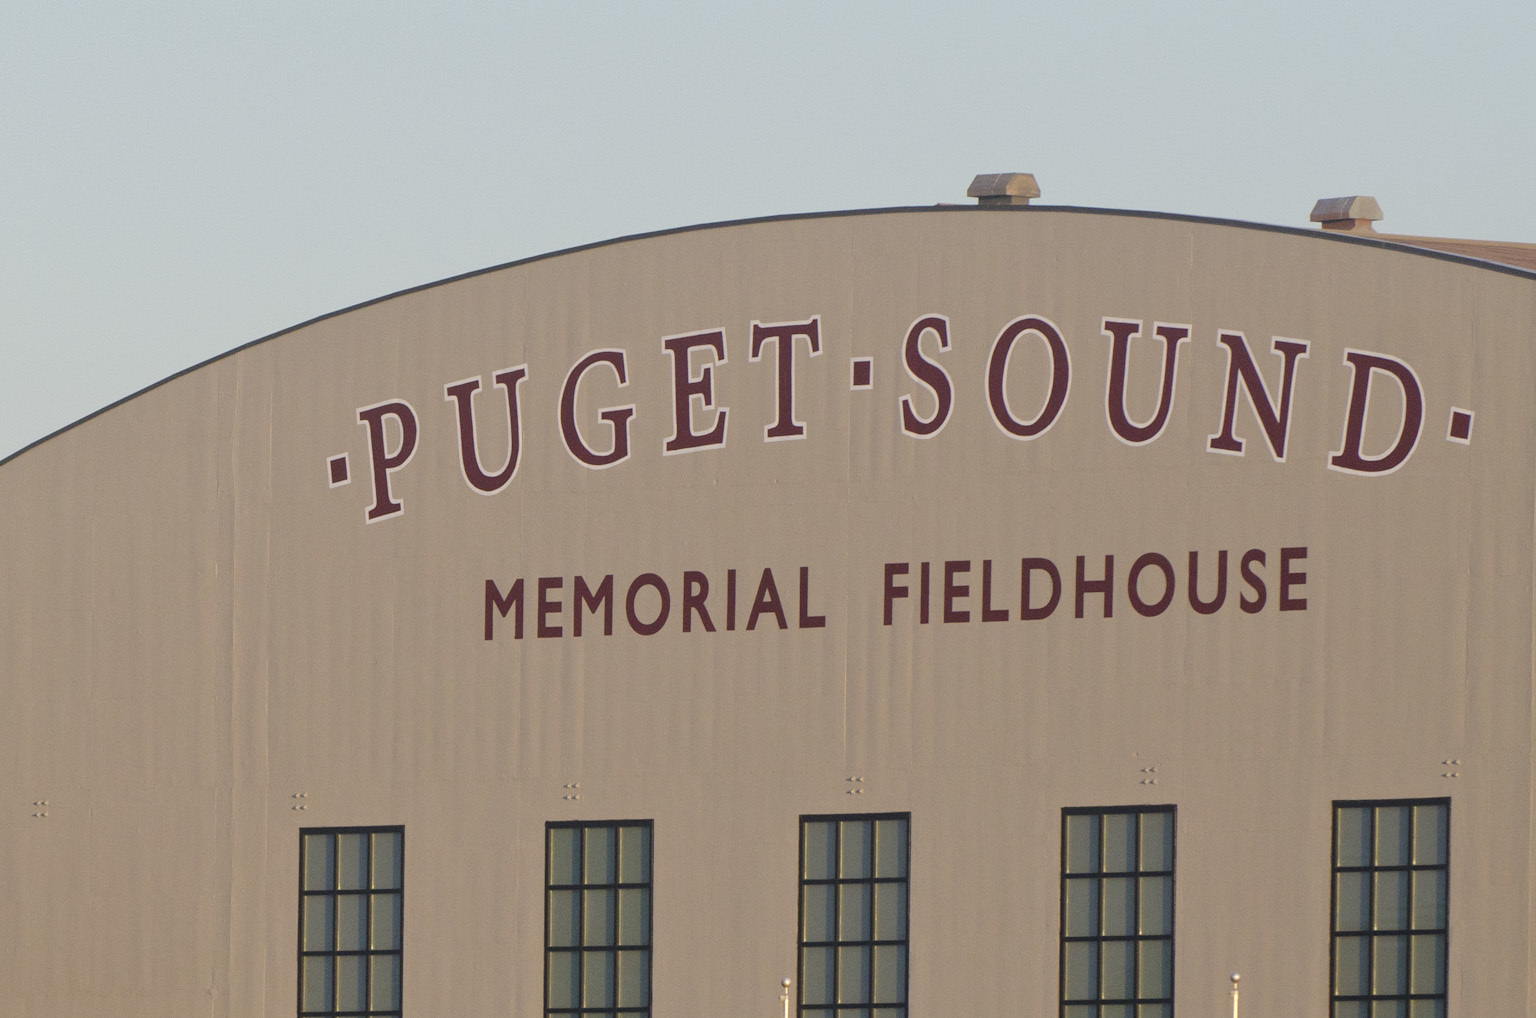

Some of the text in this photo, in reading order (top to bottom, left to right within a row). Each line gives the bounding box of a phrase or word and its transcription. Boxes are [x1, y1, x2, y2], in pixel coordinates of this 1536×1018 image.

[356, 313, 1426, 524] PUGET SOUND
[484, 546, 1308, 641] MEMORIAL FIELDHOUSE
